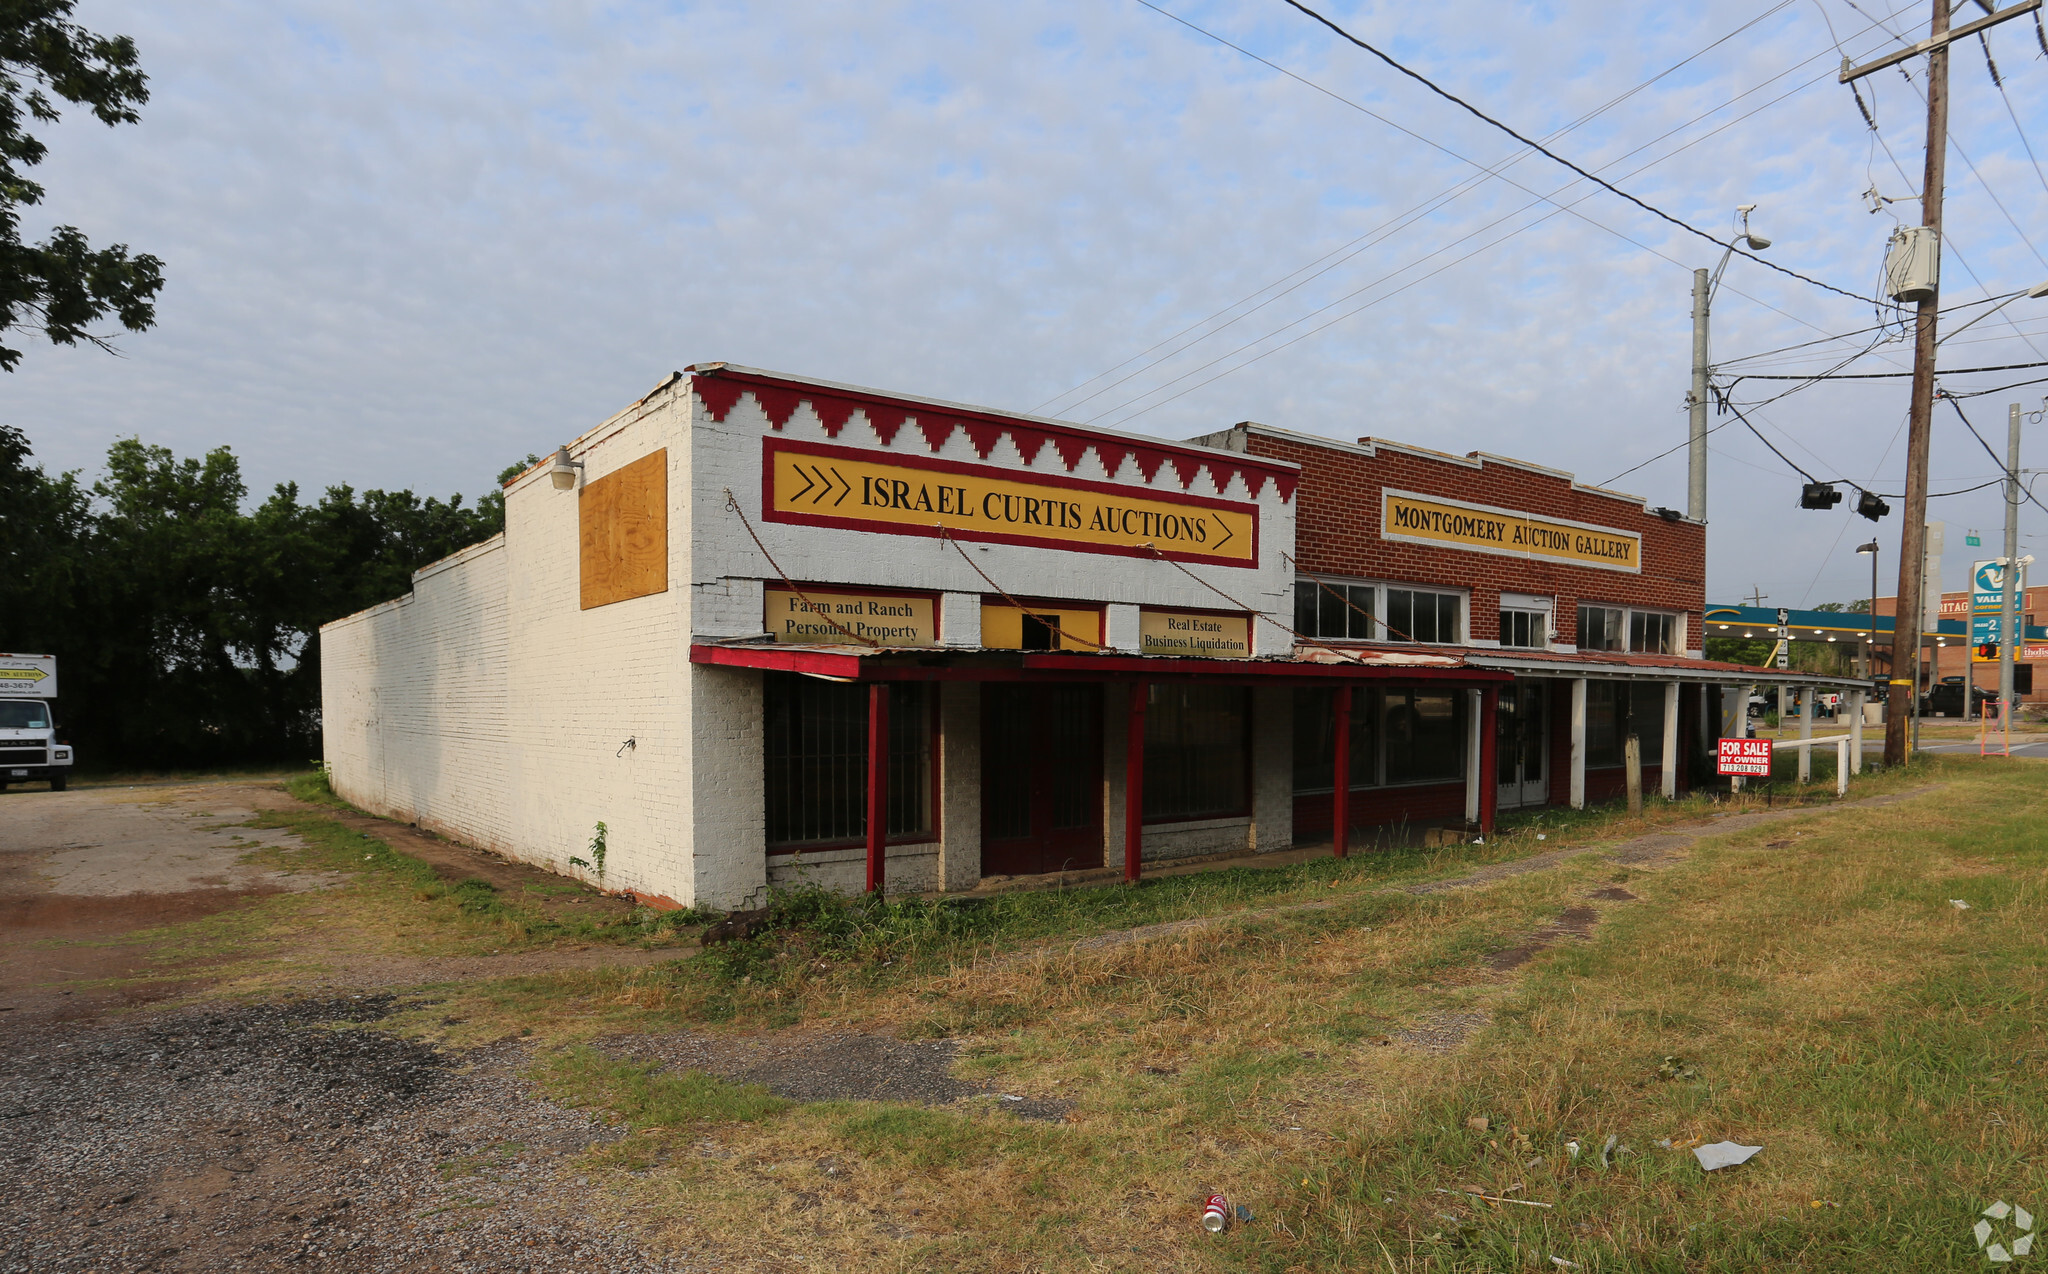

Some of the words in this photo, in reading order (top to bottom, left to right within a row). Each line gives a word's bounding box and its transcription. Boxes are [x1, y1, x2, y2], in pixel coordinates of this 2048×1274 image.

[861, 476, 974, 516] ISRAEL
[982, 492, 1082, 530] CURTIS
[1089, 505, 1206, 543] AUCTIONS
[1394, 505, 1506, 541] MONTGOMERY
[1512, 525, 1570, 551] AUCTION
[1575, 535, 1631, 560] GALLERY
[789, 597, 831, 614] Farm
[836, 601, 863, 615] and
[868, 601, 913, 617] Ranch
[785, 619, 850, 636] Personal
[856, 622, 918, 641] Property
[1168, 617, 1190, 631] Real
[1193, 619, 1222, 632] Estate
[1145, 634, 1187, 648] Business
[1190, 636, 1244, 652] Liquidation
[1721, 742, 1740, 755] FOR
[1743, 742, 1769, 756] SALE
[1733, 756, 1768, 764] OWNER
[1750, 765, 1766, 773] 0291
